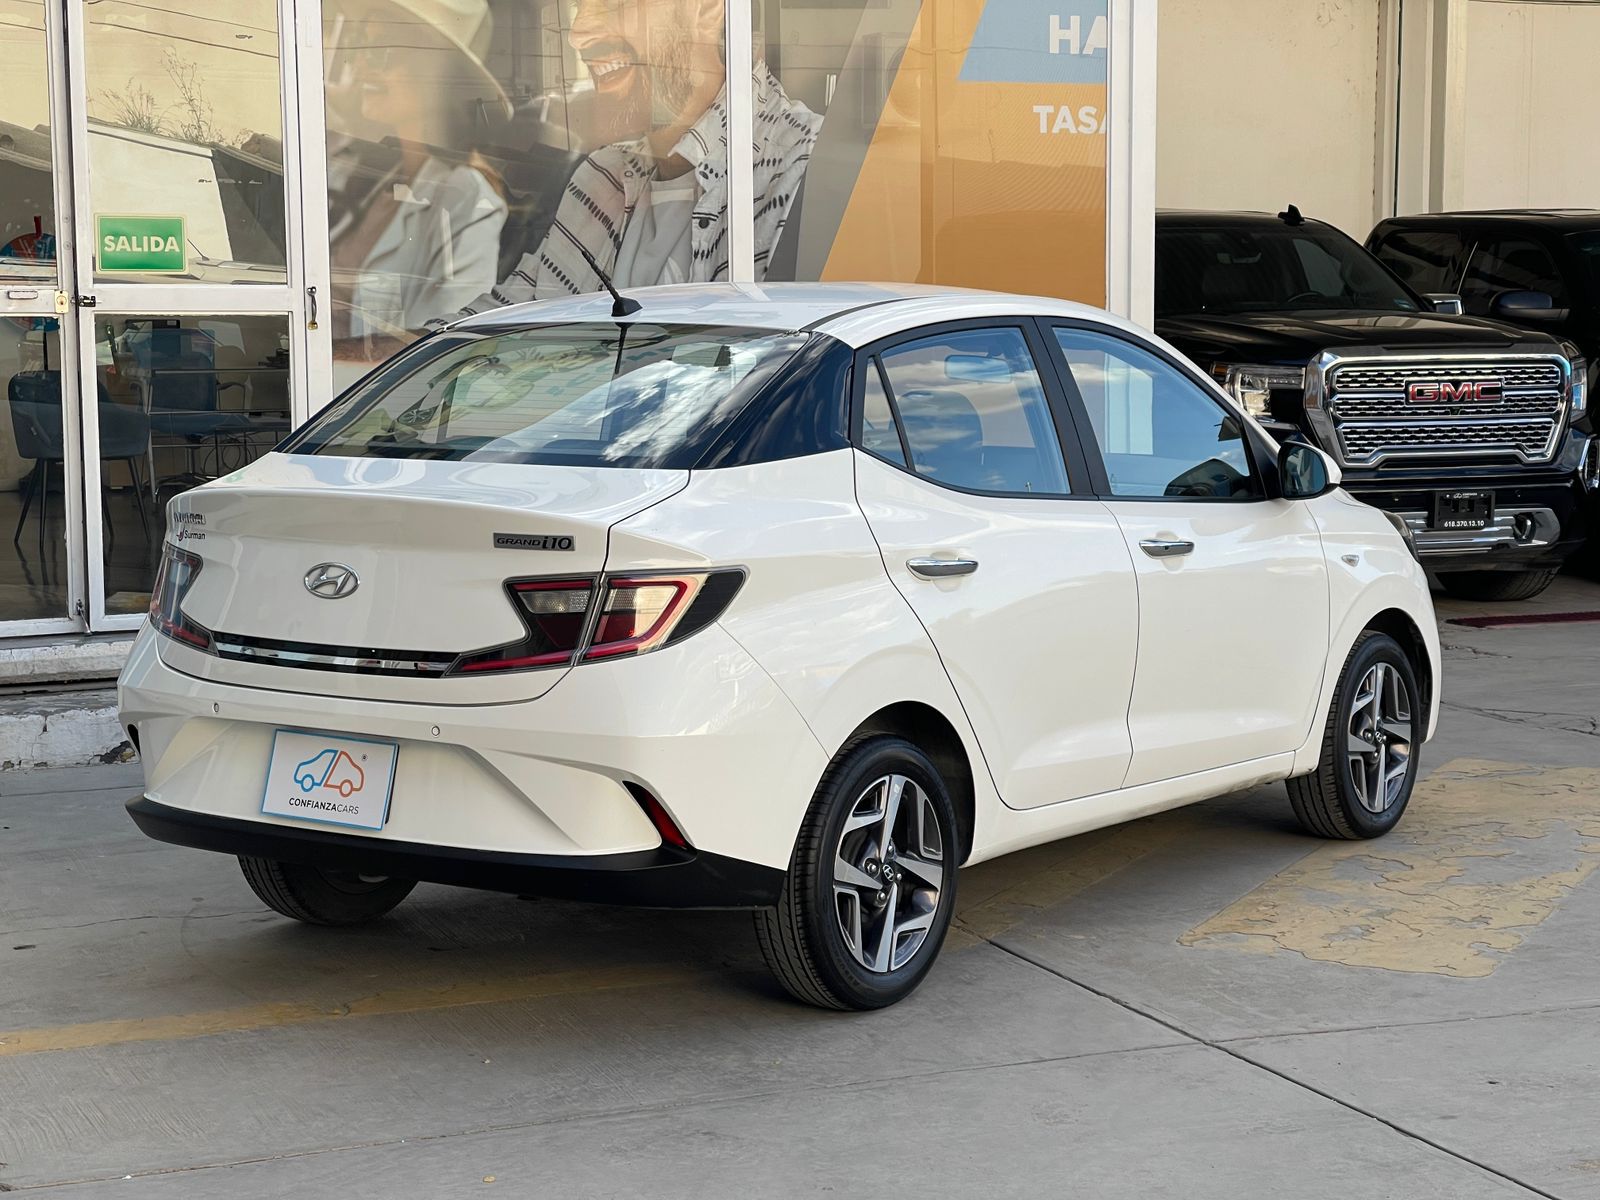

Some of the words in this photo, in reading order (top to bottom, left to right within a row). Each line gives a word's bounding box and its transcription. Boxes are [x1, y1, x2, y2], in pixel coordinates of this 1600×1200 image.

[104, 235, 180, 252] SALIDA
[1409, 382, 1502, 402] GMC
[184, 529, 206, 539] Surman
[496, 537, 541, 546] GRAND
[541, 536, 572, 550] i10
